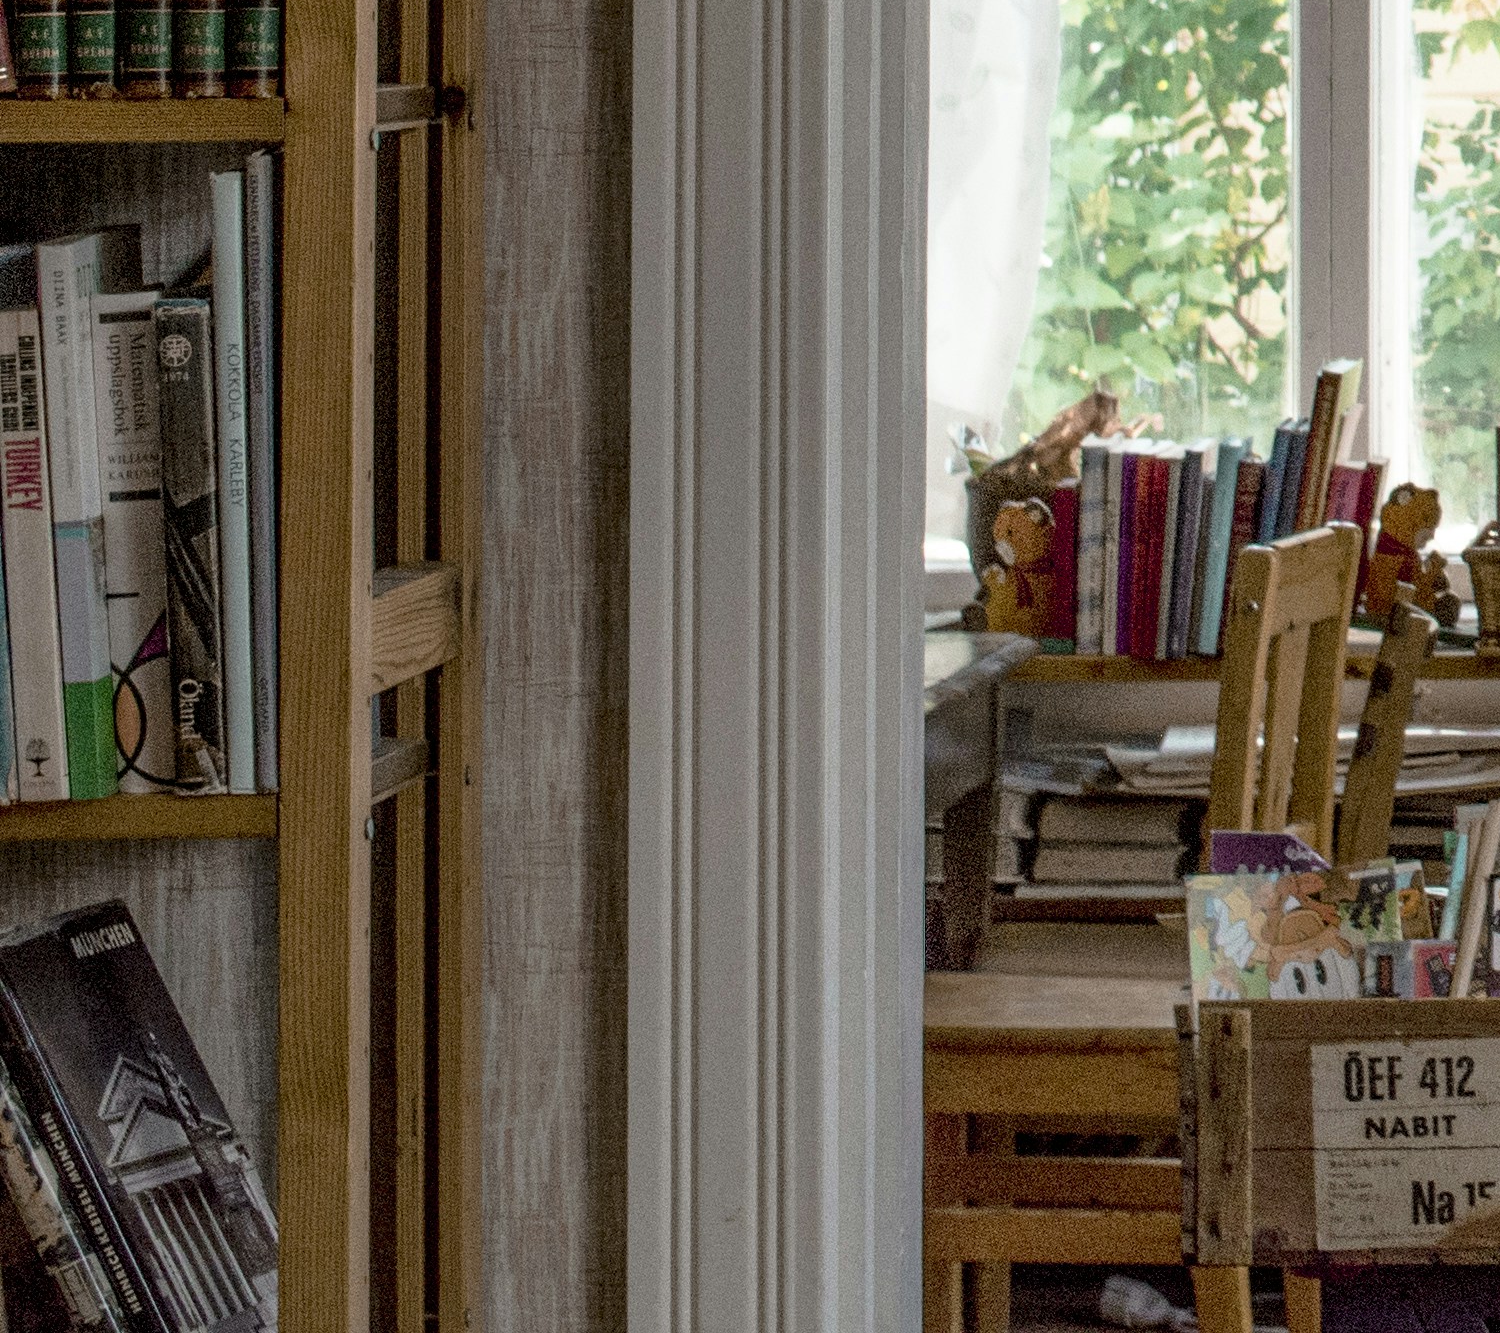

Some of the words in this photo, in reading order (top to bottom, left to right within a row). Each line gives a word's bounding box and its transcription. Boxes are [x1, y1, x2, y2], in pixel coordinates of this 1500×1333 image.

[18, 335, 36, 370] COLLINS
[130, 332, 151, 432] Matematisk
[226, 342, 242, 421] KOKKOLA
[21, 372, 39, 431] INDEPENDENT
[106, 333, 129, 437] uppslagsbok
[5, 436, 43, 511] TURKEY
[228, 437, 244, 508] KARLEBY
[177, 677, 206, 739] Öland
[70, 922, 136, 960] MÜNCHEN
[1344, 1051, 1402, 1101] ÖEF
[1419, 1056, 1475, 1097] 412
[1365, 1114, 1457, 1140] NABIT
[1412, 1181, 1454, 1225] Na
